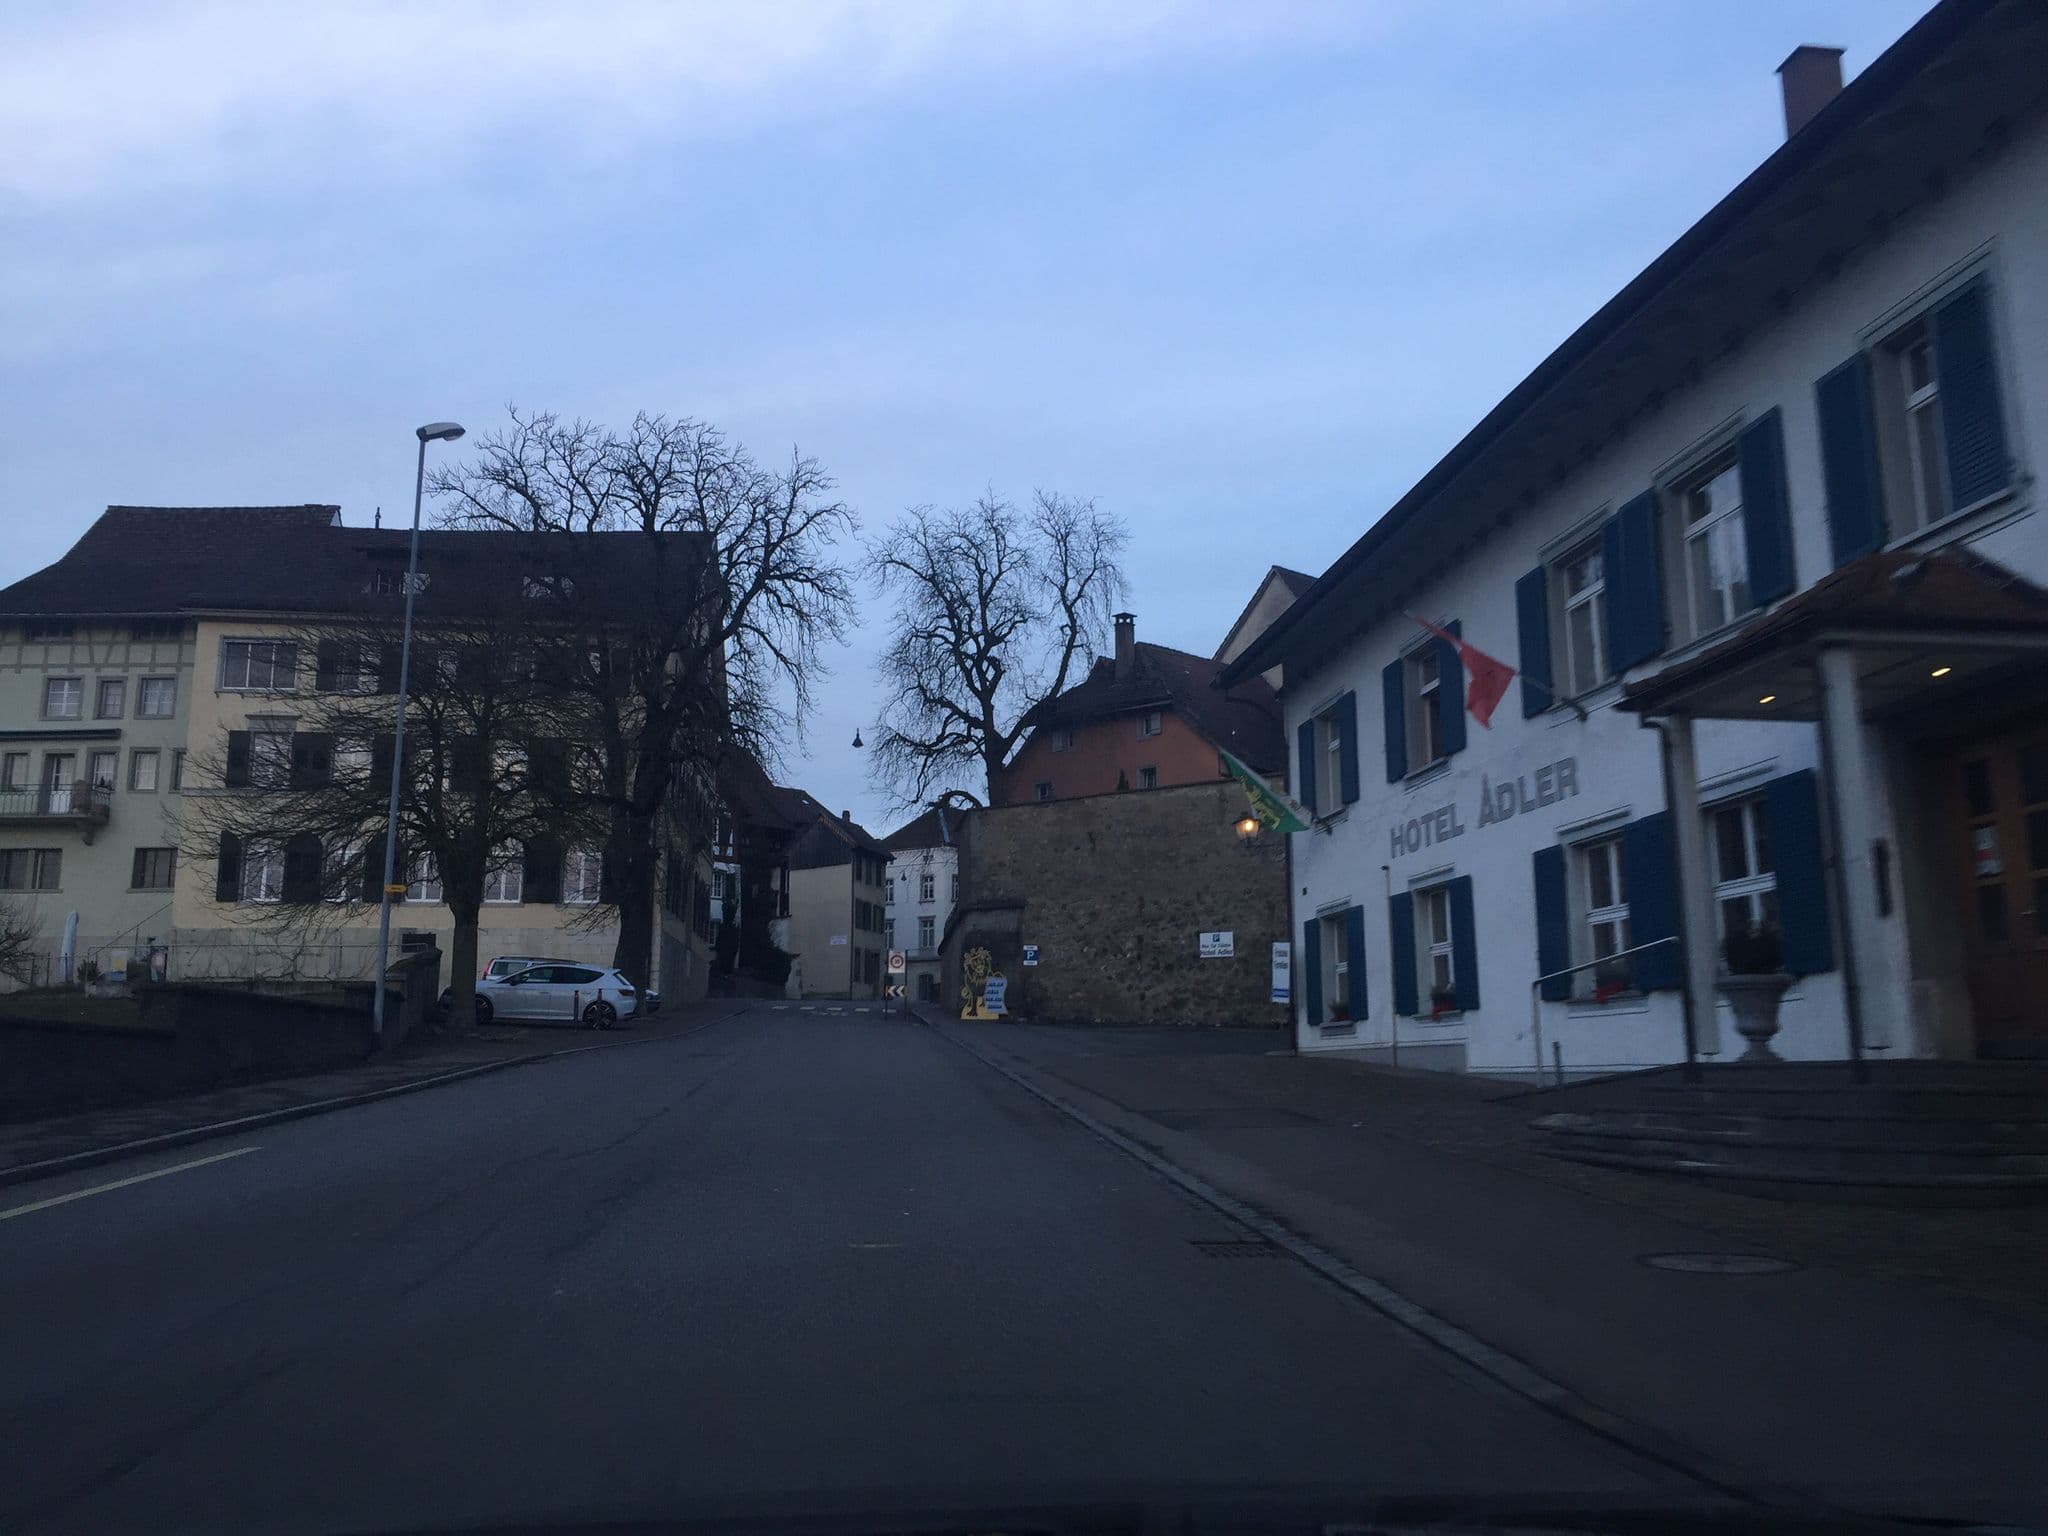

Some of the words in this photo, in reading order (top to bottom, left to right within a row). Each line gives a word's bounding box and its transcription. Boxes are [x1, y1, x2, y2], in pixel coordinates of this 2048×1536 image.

[1391, 803, 1464, 859] HOTEL
[1478, 757, 1580, 829] ADLER
[1026, 951, 1034, 960] P
